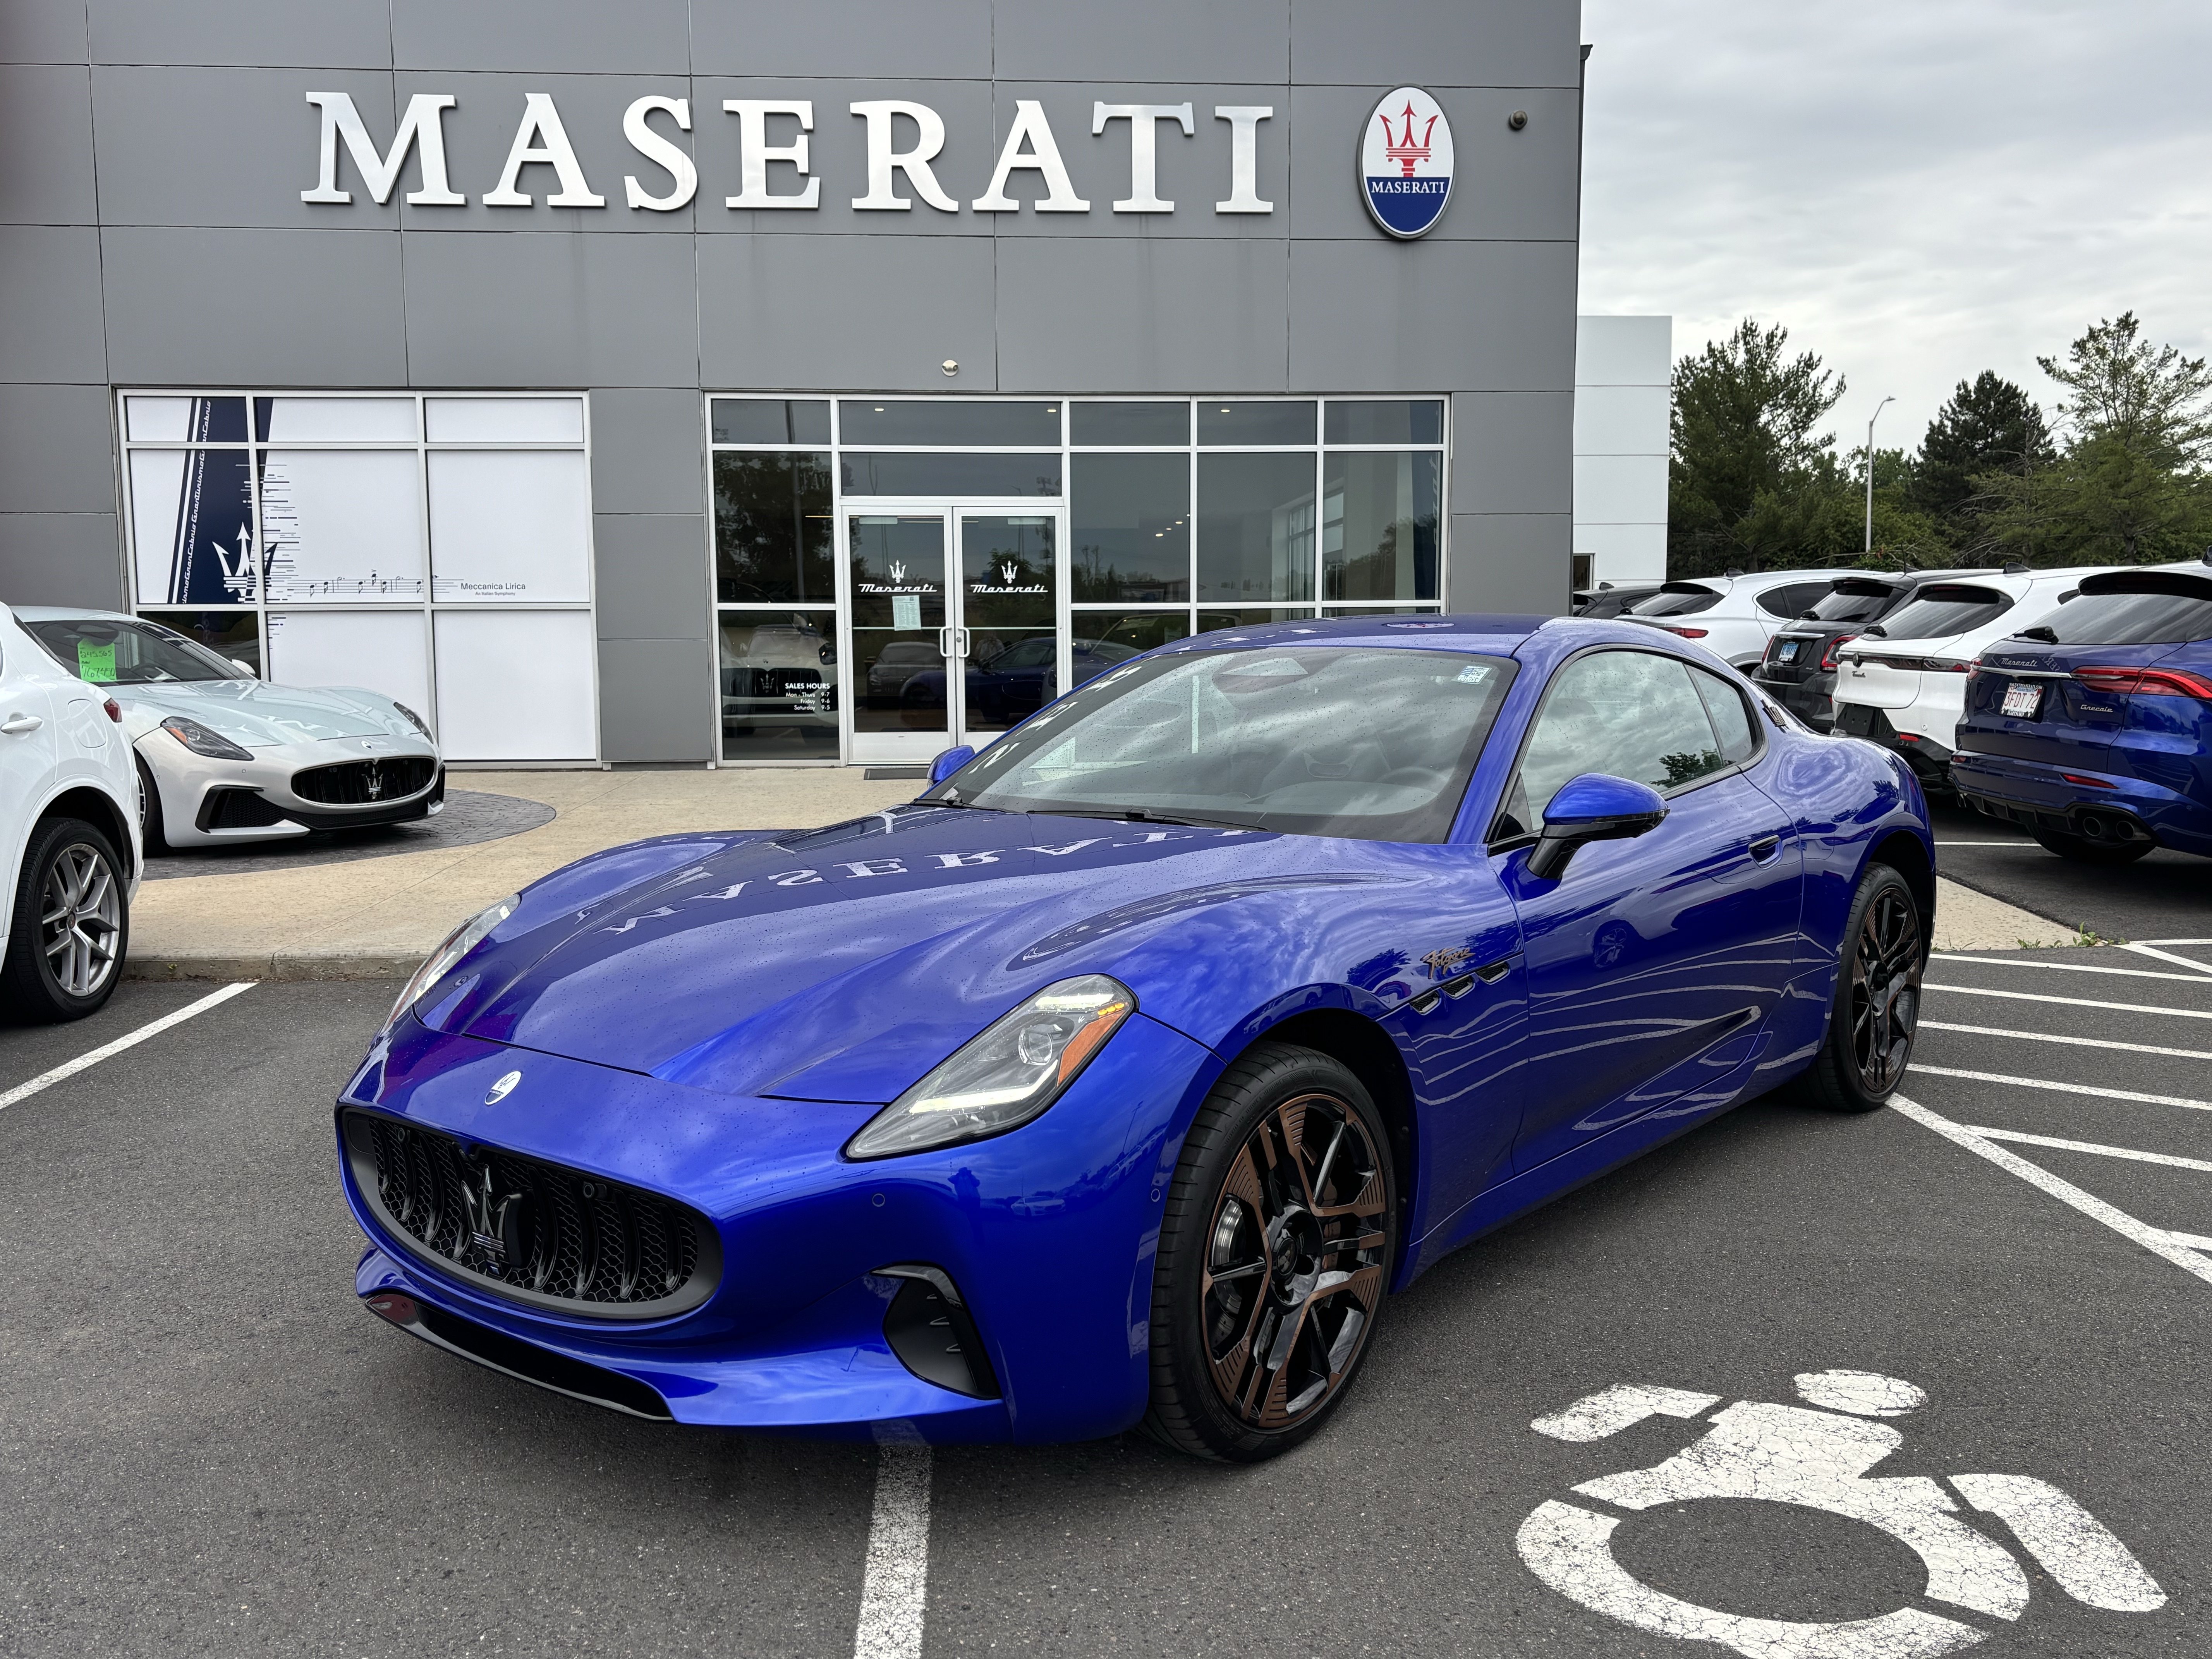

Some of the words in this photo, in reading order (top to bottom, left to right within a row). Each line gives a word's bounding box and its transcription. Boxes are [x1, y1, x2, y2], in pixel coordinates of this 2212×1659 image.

[301, 91, 1273, 214] MASERATI
[1371, 181, 1445, 194] MASERATI
[858, 583, 937, 592] Maserati
[970, 584, 1049, 593] Maserati
[2001, 658, 2038, 667] Maserati
[2080, 704, 2113, 713] Grecale
